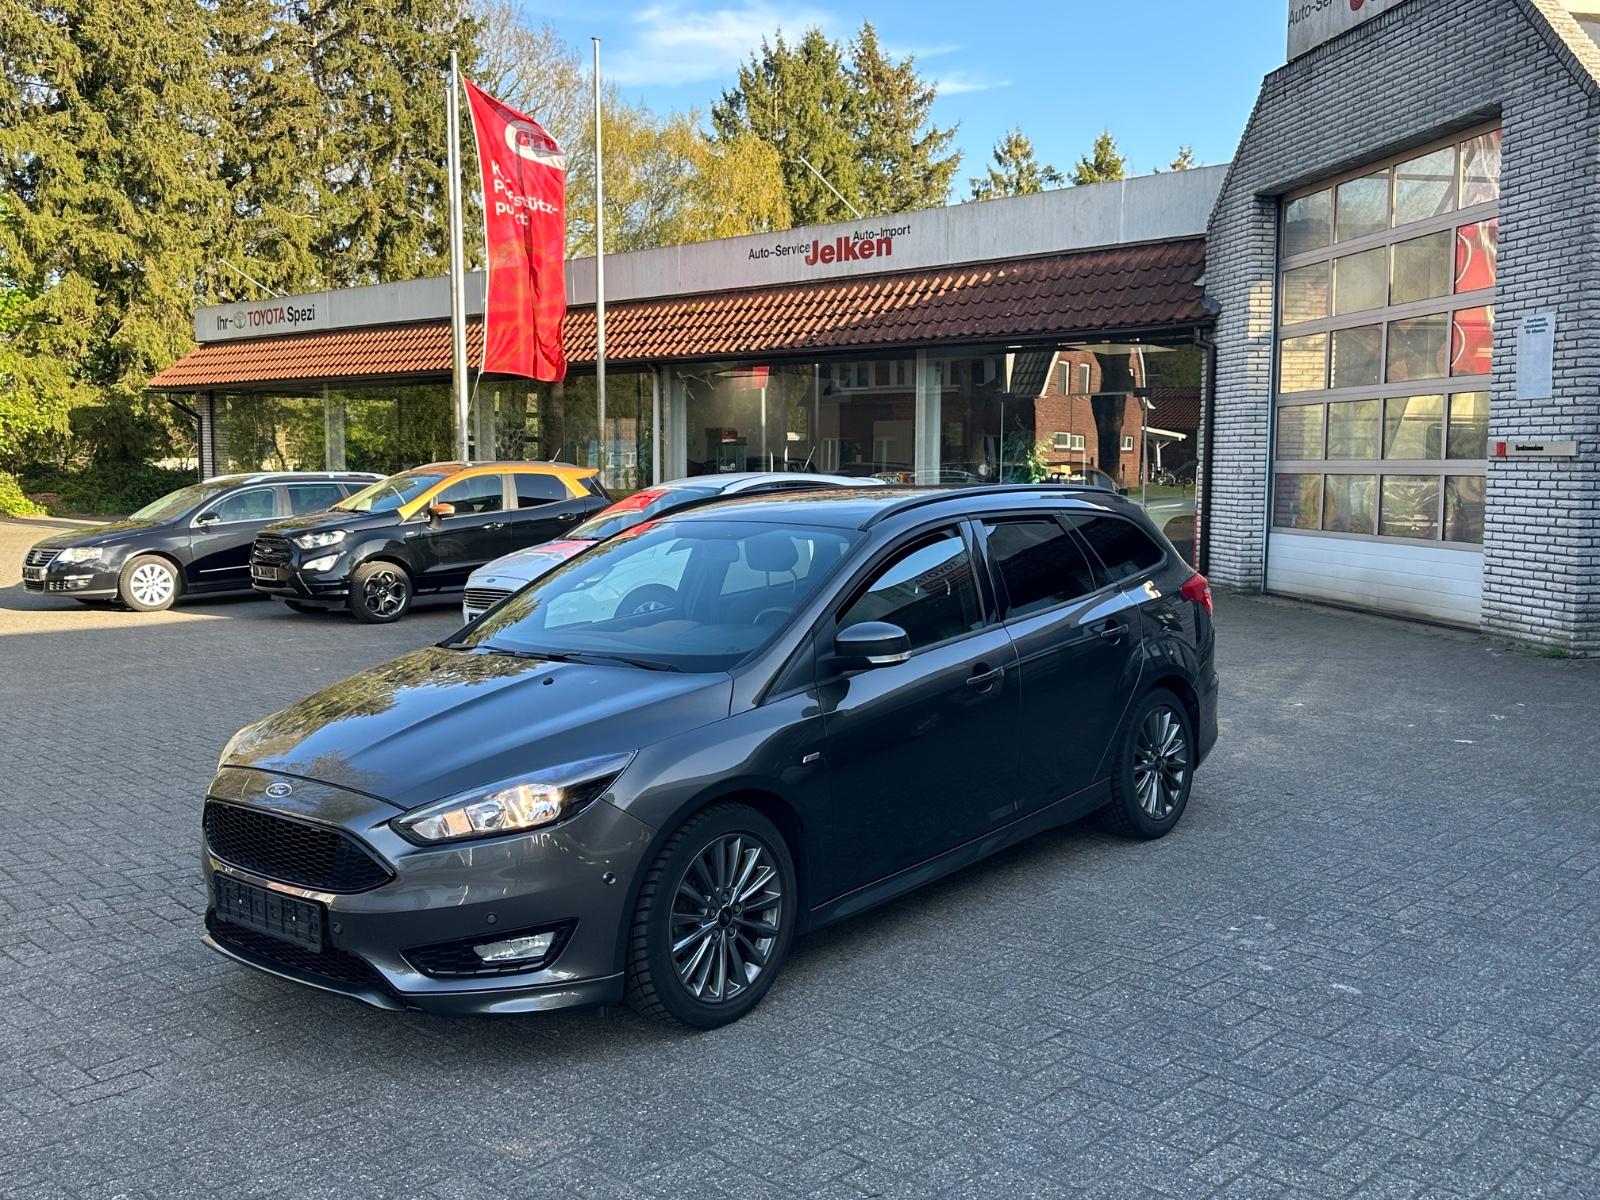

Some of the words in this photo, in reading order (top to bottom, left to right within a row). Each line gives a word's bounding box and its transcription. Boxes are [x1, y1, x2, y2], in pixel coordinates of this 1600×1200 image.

[853, 224, 911, 242] Auto-Import
[748, 242, 811, 260] Auto-Service
[805, 236, 892, 266] Jelken
[247, 307, 286, 327] TOYOTA
[287, 303, 316, 326] Spezi
